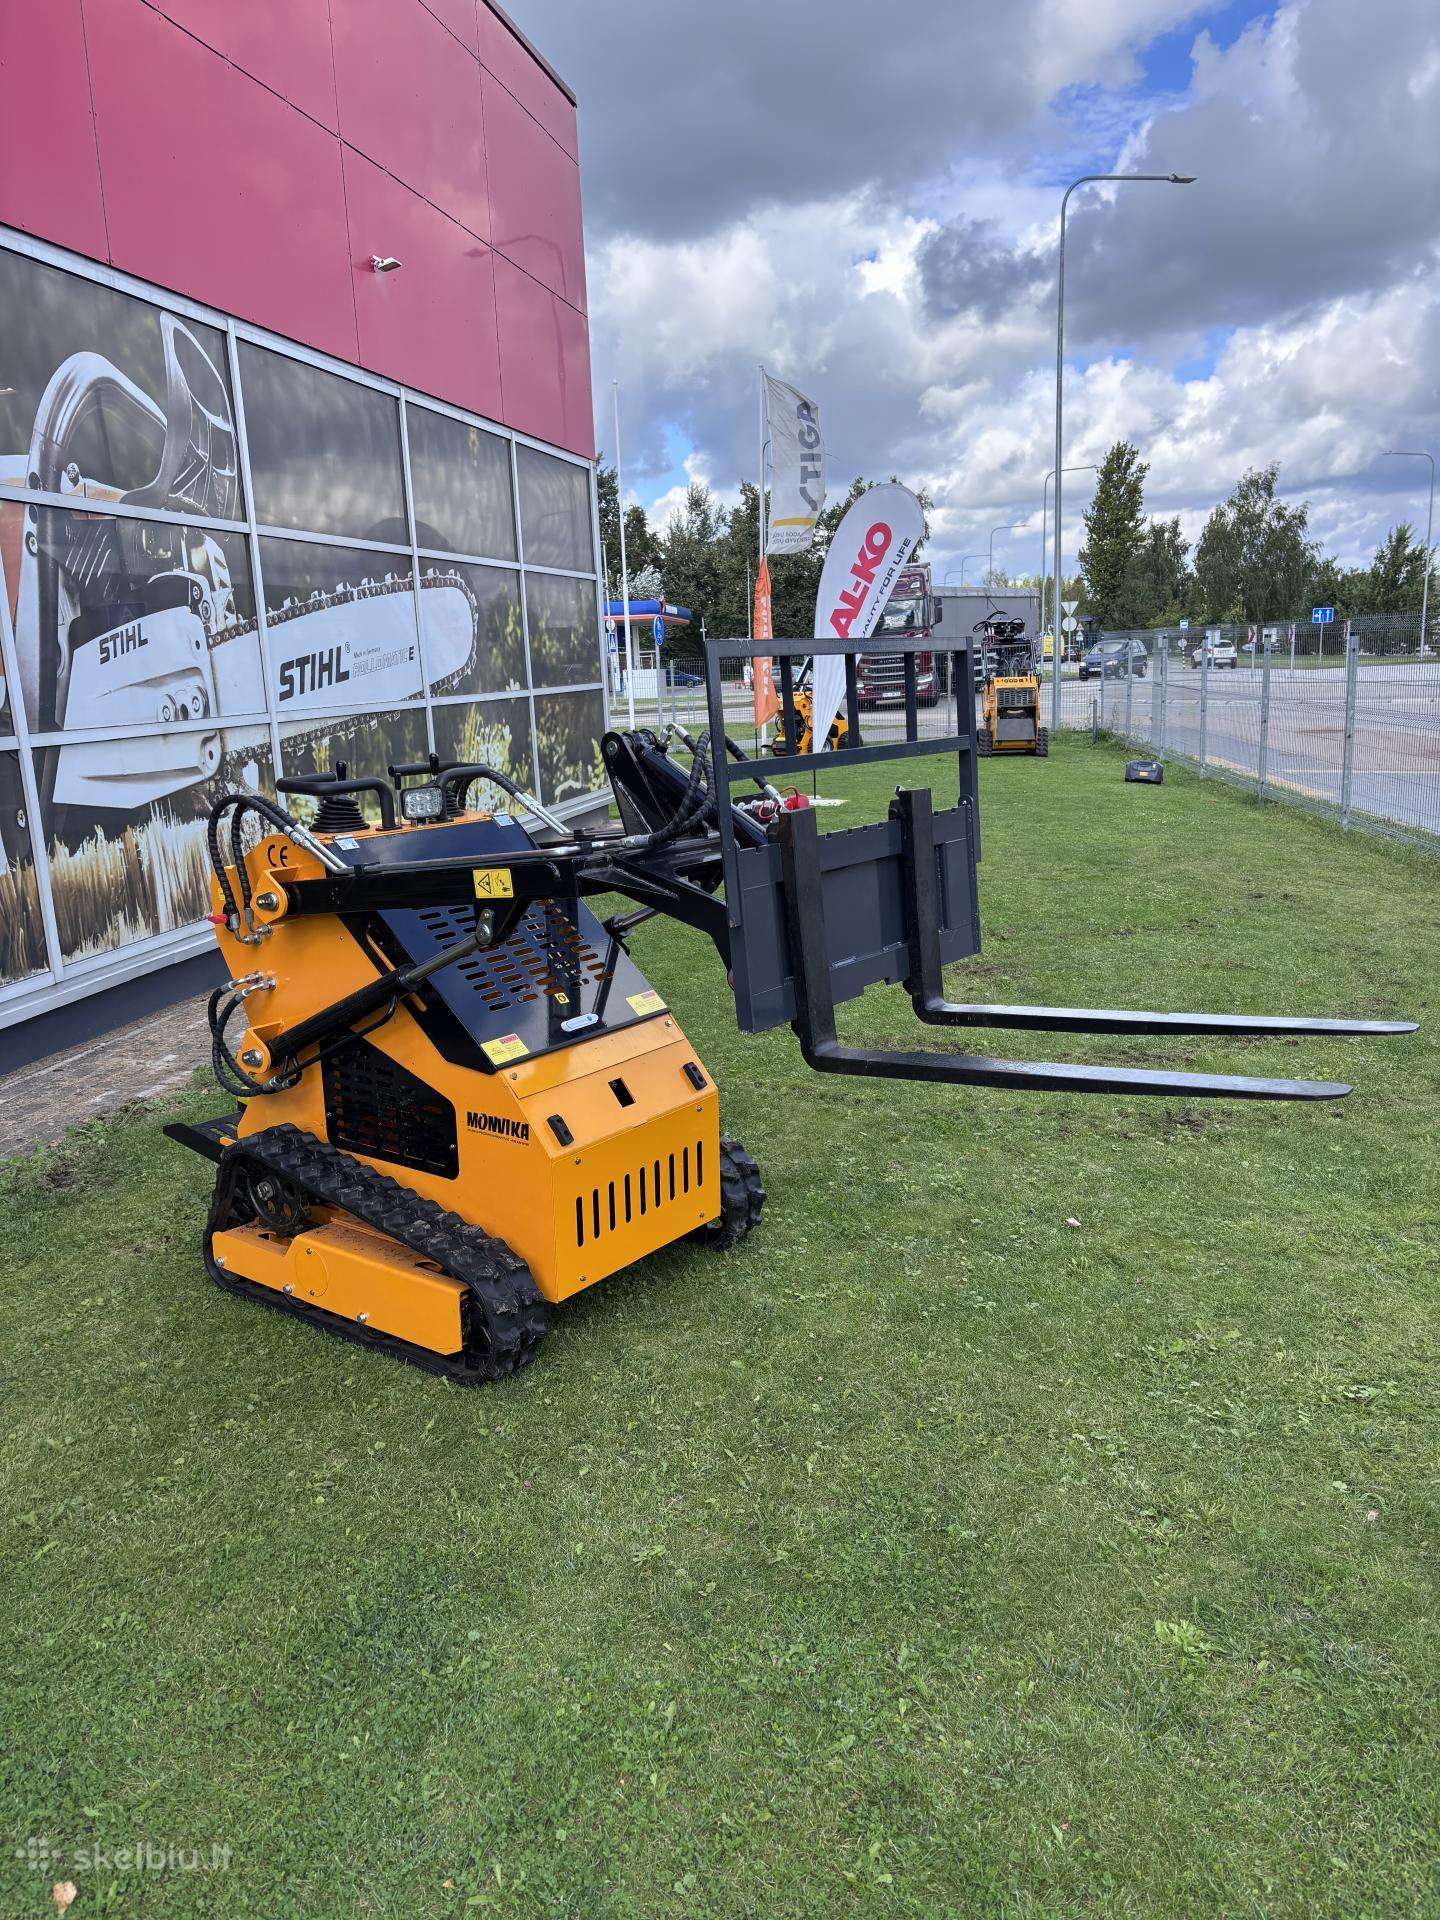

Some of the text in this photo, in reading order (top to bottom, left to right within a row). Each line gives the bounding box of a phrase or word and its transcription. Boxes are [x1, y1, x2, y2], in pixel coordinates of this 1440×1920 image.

[797, 401, 821, 511] STIGA
[829, 522, 892, 639] AL-KO
[880, 567, 896, 595] FOR
[893, 538, 911, 566] LIFE
[99, 623, 148, 664] STIHL
[409, 646, 414, 661] E
[279, 646, 349, 701] STIHL
[268, 844, 288, 867] CE
